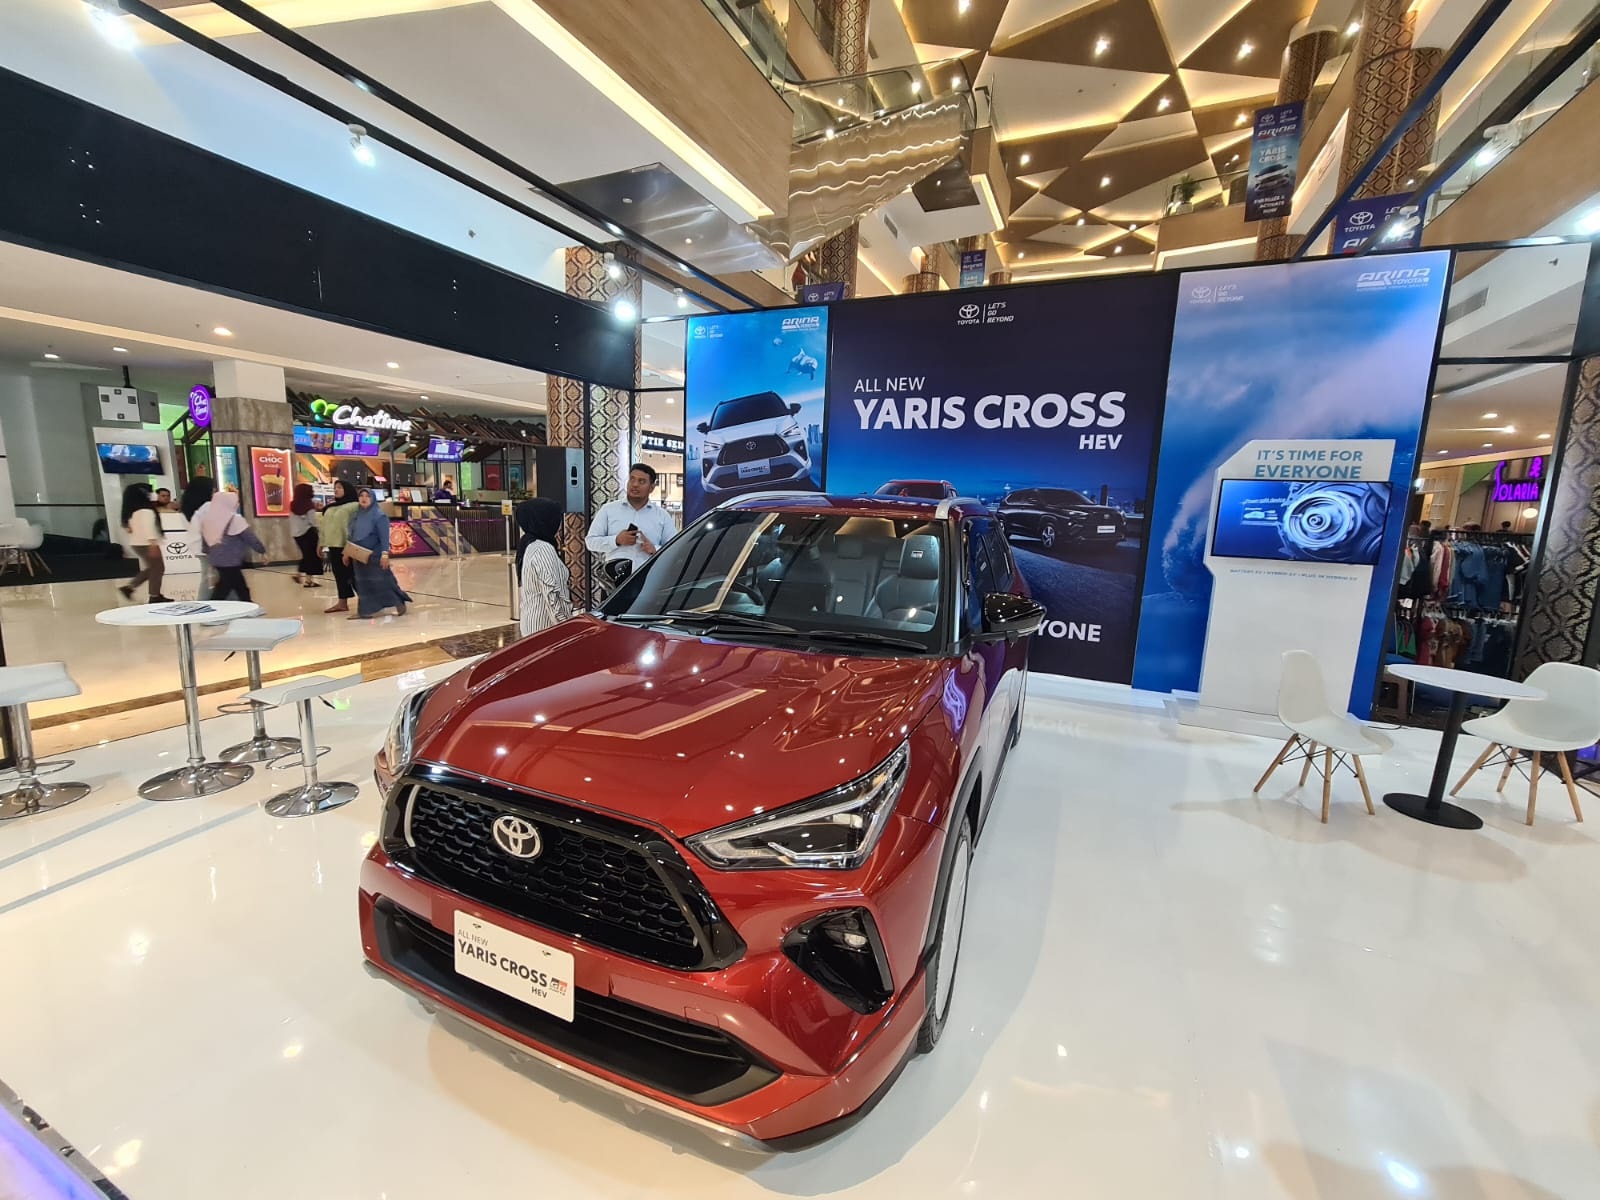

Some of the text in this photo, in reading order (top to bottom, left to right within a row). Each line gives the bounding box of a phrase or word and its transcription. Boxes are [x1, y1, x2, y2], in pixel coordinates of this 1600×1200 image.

[1344, 224, 1376, 232] TOYOTA
[1357, 268, 1431, 285] ARINA
[1392, 277, 1425, 285] TOYOTA
[987, 315, 1014, 323] BEYOND
[854, 377, 925, 392] ALL NEW
[332, 404, 411, 431] Chatime
[854, 391, 1127, 430] YARIS CROSS
[641, 435, 664, 446] PTIK
[1078, 434, 1123, 450] HEV
[1257, 450, 1364, 461] IT'S TIME FOR
[1255, 464, 1362, 479] EVERYONE
[1037, 620, 1101, 642] YONE
[457, 929, 489, 946] ALL NEW
[458, 938, 548, 988] YARIS CROSS
[531, 986, 548, 998] HEV
